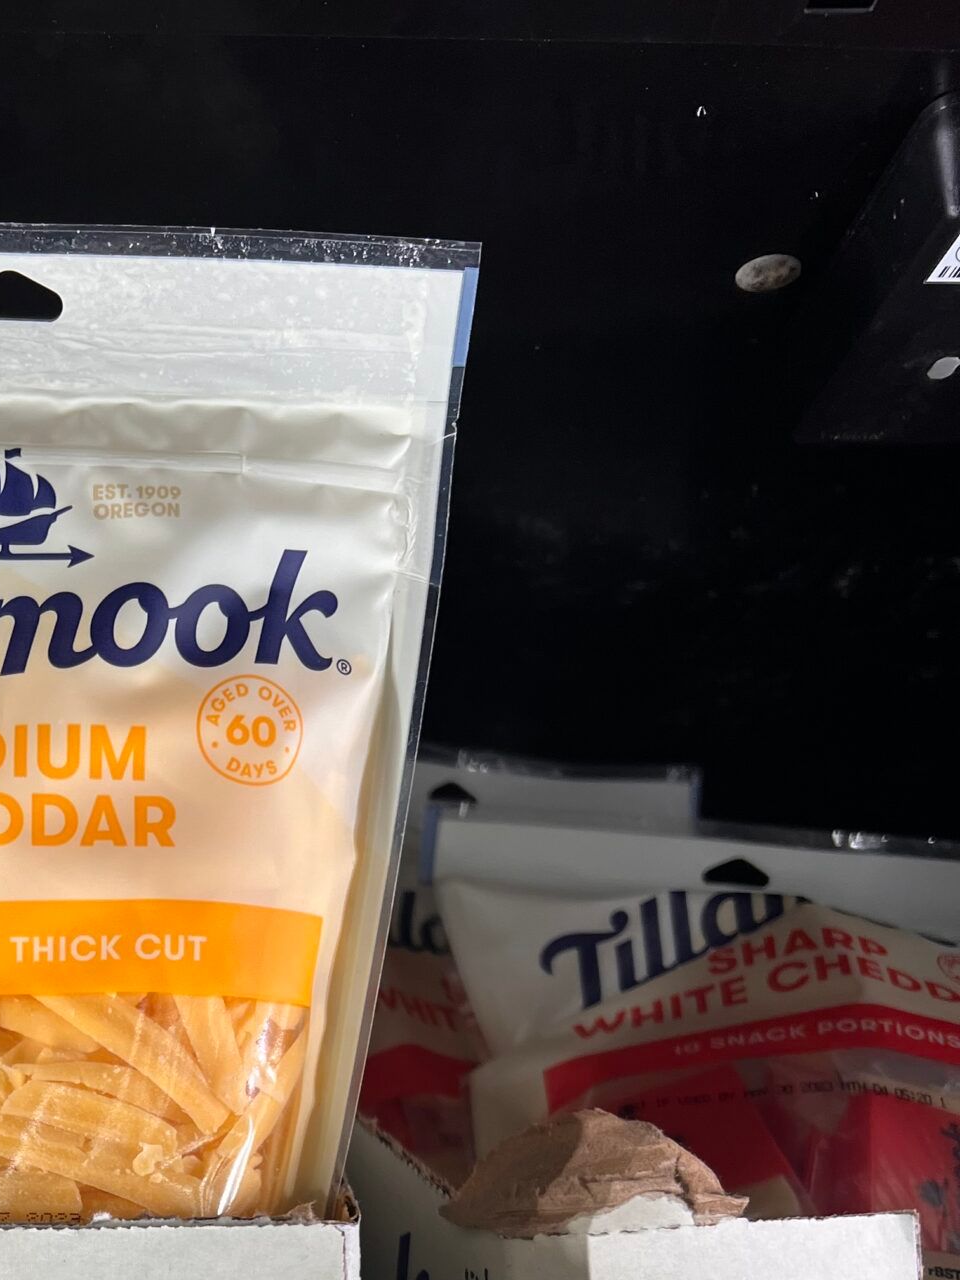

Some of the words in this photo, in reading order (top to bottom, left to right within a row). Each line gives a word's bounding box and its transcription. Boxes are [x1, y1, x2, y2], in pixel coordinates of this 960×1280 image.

[92, 484, 131, 501] EST.
[136, 485, 182, 501] 1909
[92, 502, 181, 520] OREGON
[206, 683, 249, 726] AGED
[258, 686, 296, 732] OVER
[226, 714, 277, 748] 60
[226, 757, 278, 778] DAYS
[11, 934, 122, 963] THICK
[134, 934, 208, 962] CUT
[707, 927, 889, 976] SHARP
[573, 975, 748, 1040] WHITE
[709, 1026, 808, 1049] SNACK
